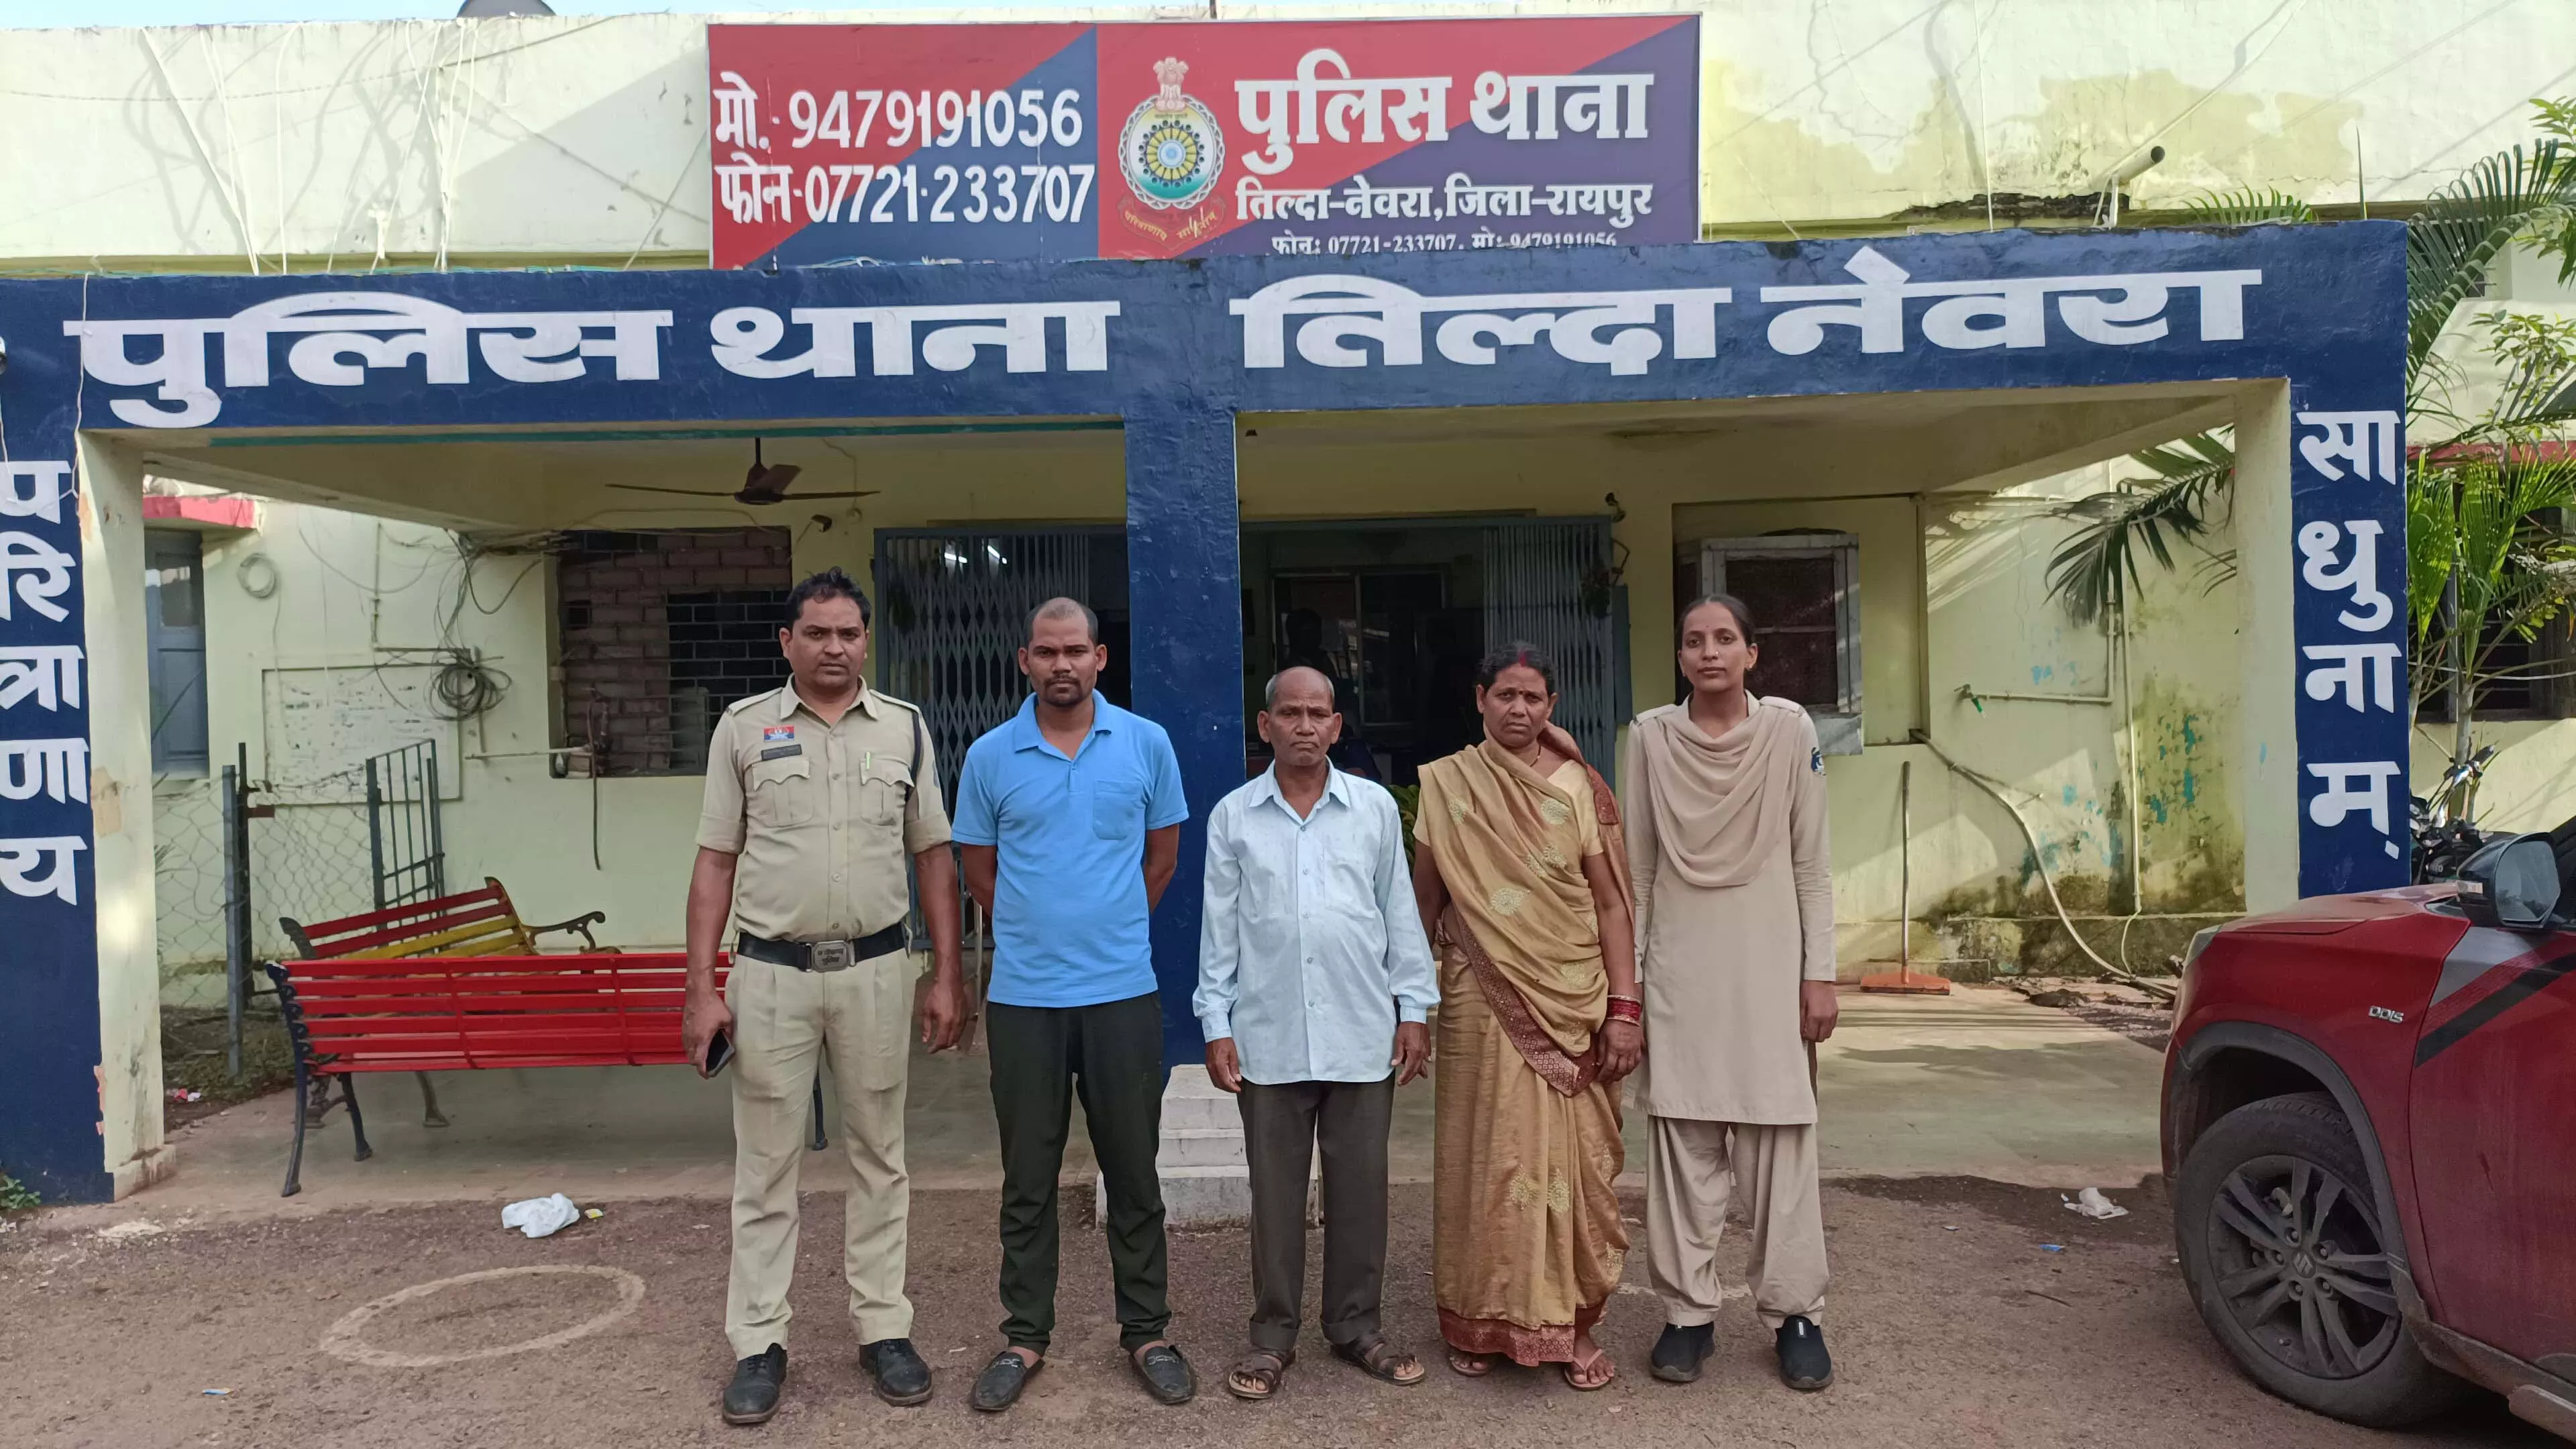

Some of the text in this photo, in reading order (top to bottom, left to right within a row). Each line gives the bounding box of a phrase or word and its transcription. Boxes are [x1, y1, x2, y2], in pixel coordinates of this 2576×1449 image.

[789, 89, 1083, 148] 9479191056
[1234, 48, 1654, 174] पुलिस थाना
[63, 246, 2262, 428] पुलिस थाना तिल्दा नेवरा
